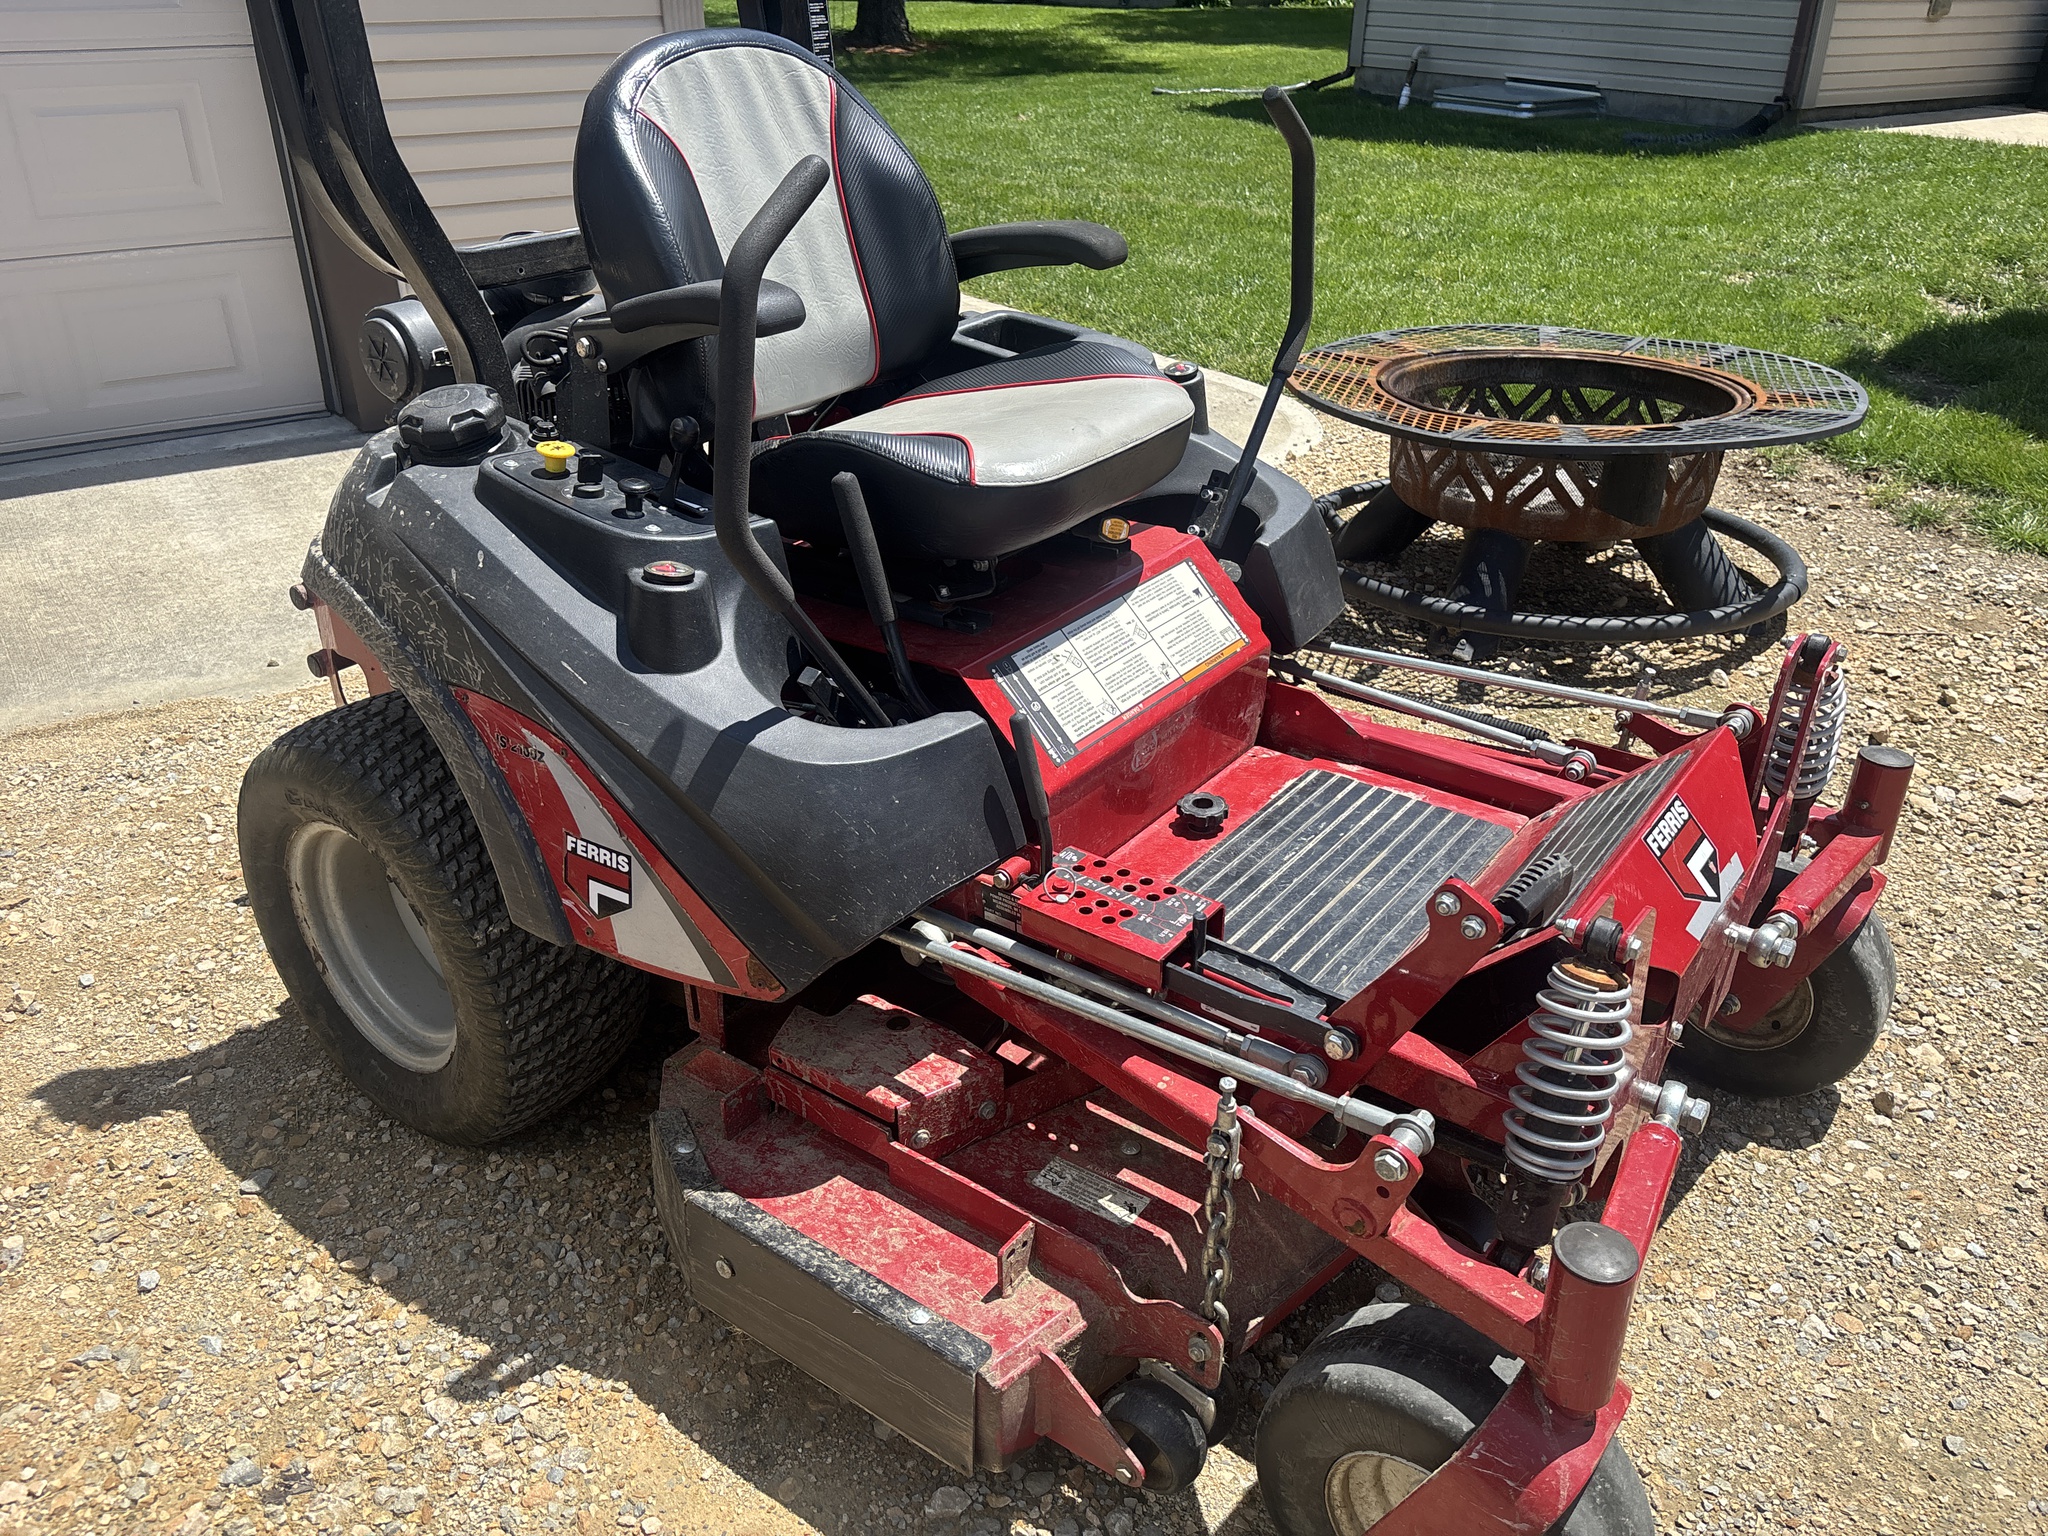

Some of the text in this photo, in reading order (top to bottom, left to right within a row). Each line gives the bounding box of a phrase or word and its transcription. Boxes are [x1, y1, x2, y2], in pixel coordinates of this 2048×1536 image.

[1204, 654, 1221, 667] WARNING
[1121, 705, 1140, 719] DANGER
[1646, 799, 1690, 857] FERRIS
[566, 835, 630, 873] FERRIS
